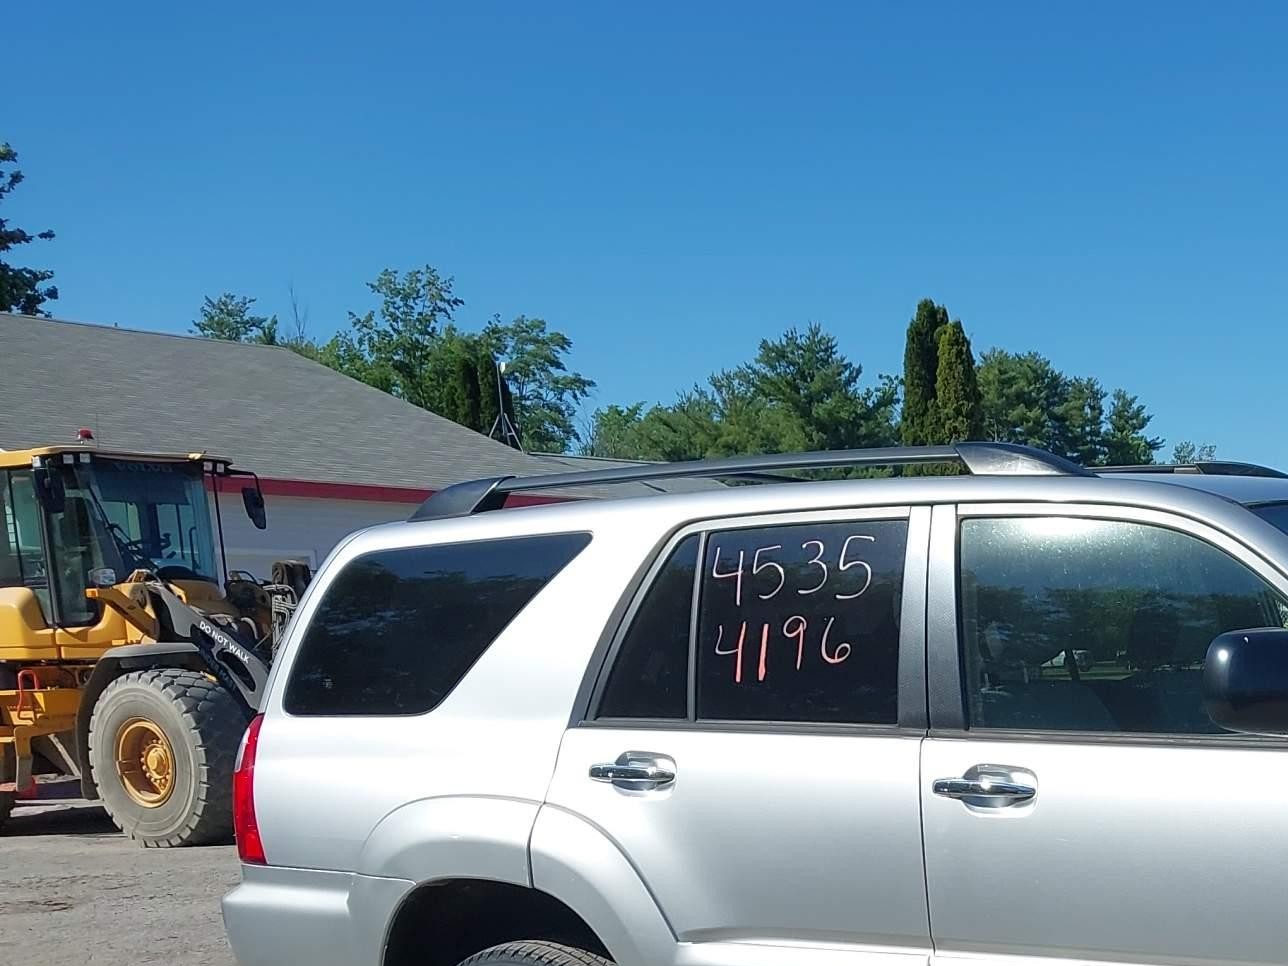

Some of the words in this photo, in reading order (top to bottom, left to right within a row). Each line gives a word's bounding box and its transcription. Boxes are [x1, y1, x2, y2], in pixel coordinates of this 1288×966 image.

[712, 535, 876, 606] 4535
[199, 620, 211, 634] DO
[212, 628, 228, 646] NOT
[229, 642, 250, 664] WALK
[715, 615, 852, 683] 4196
